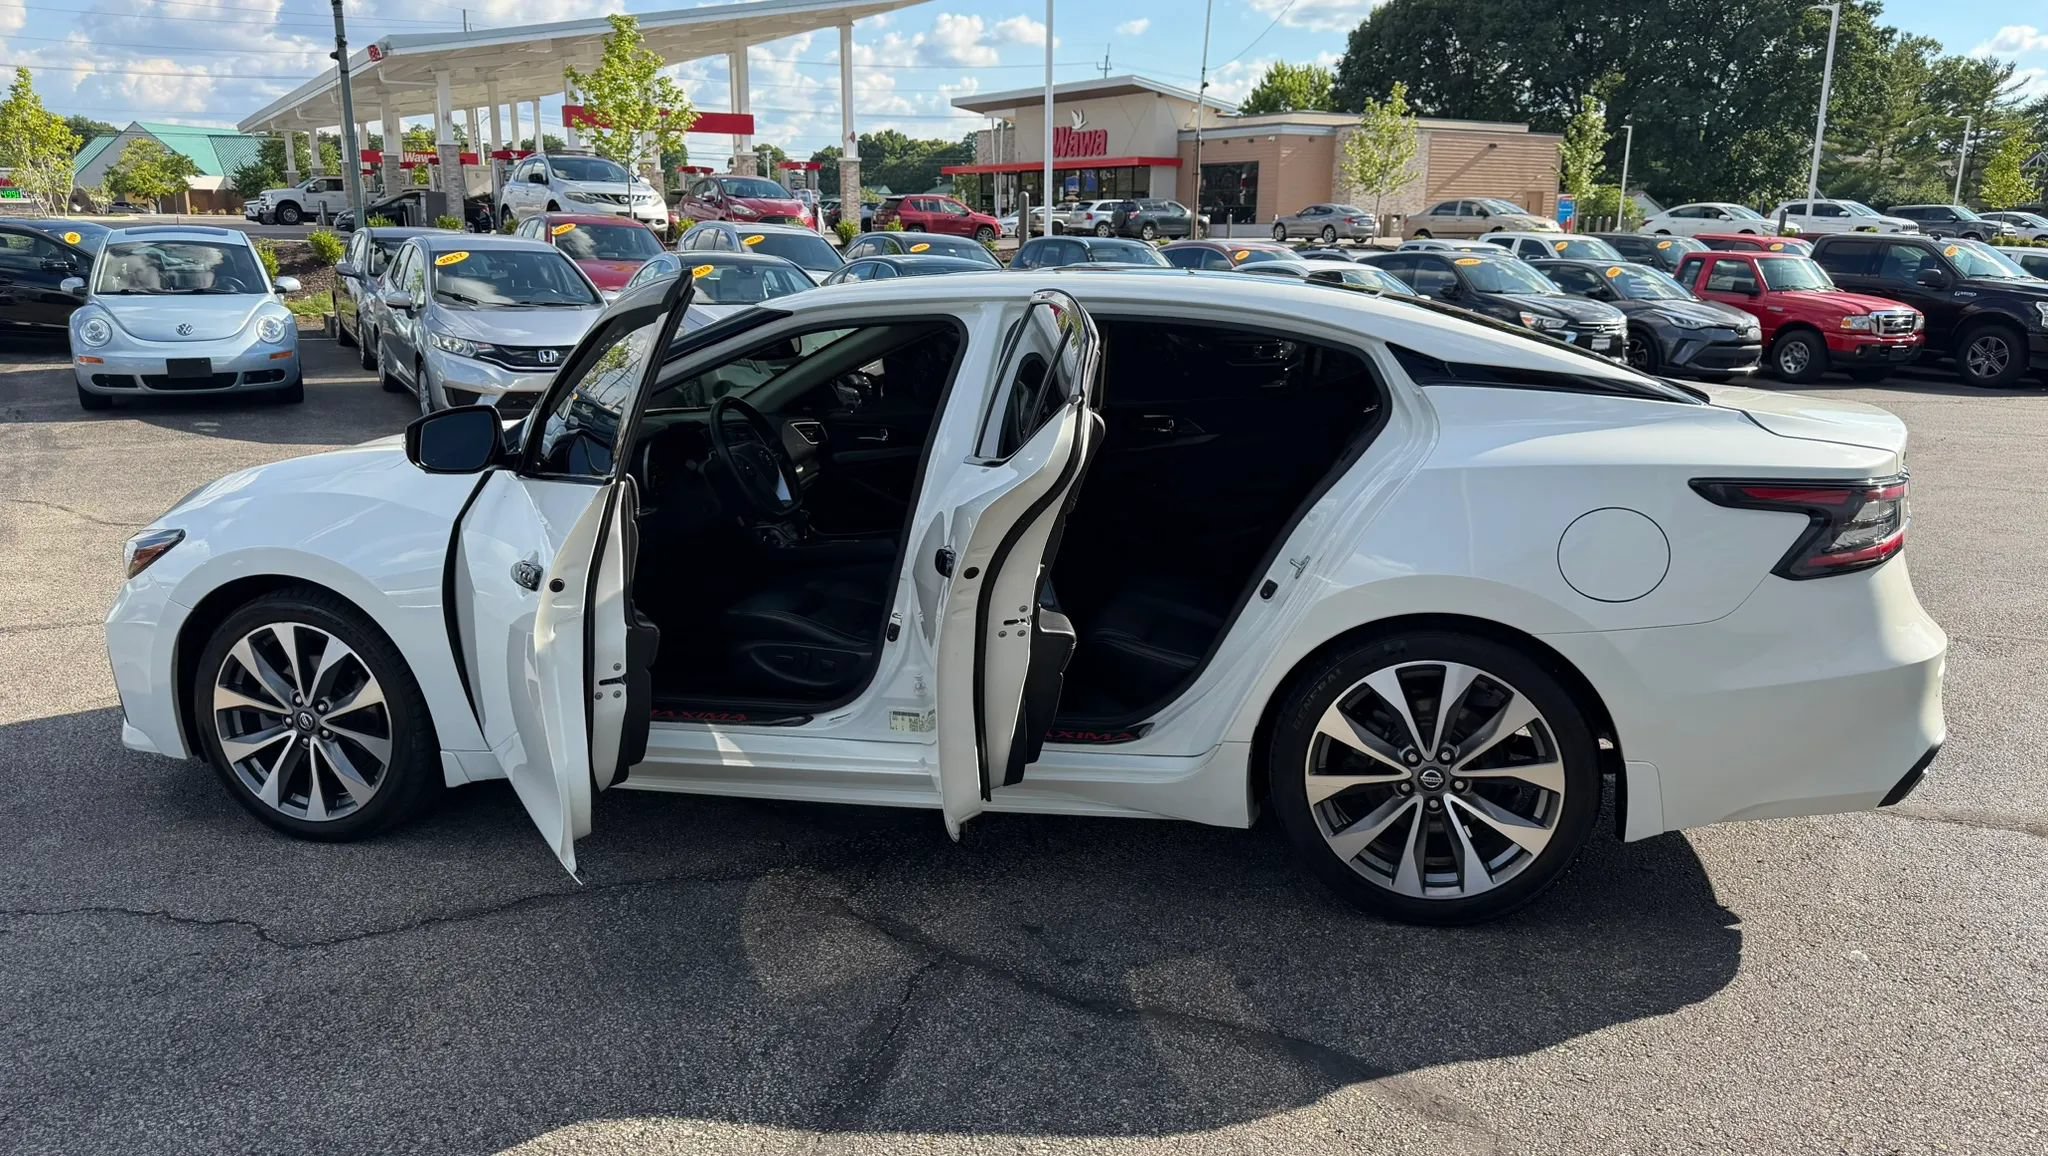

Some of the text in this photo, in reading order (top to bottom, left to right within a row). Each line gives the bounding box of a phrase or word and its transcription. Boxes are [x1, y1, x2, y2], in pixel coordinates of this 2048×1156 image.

[1053, 127, 1108, 158] Wawa
[439, 252, 464, 263] 2017
[651, 709, 747, 721] AXIMA
[1045, 730, 1136, 741] AXIMA
